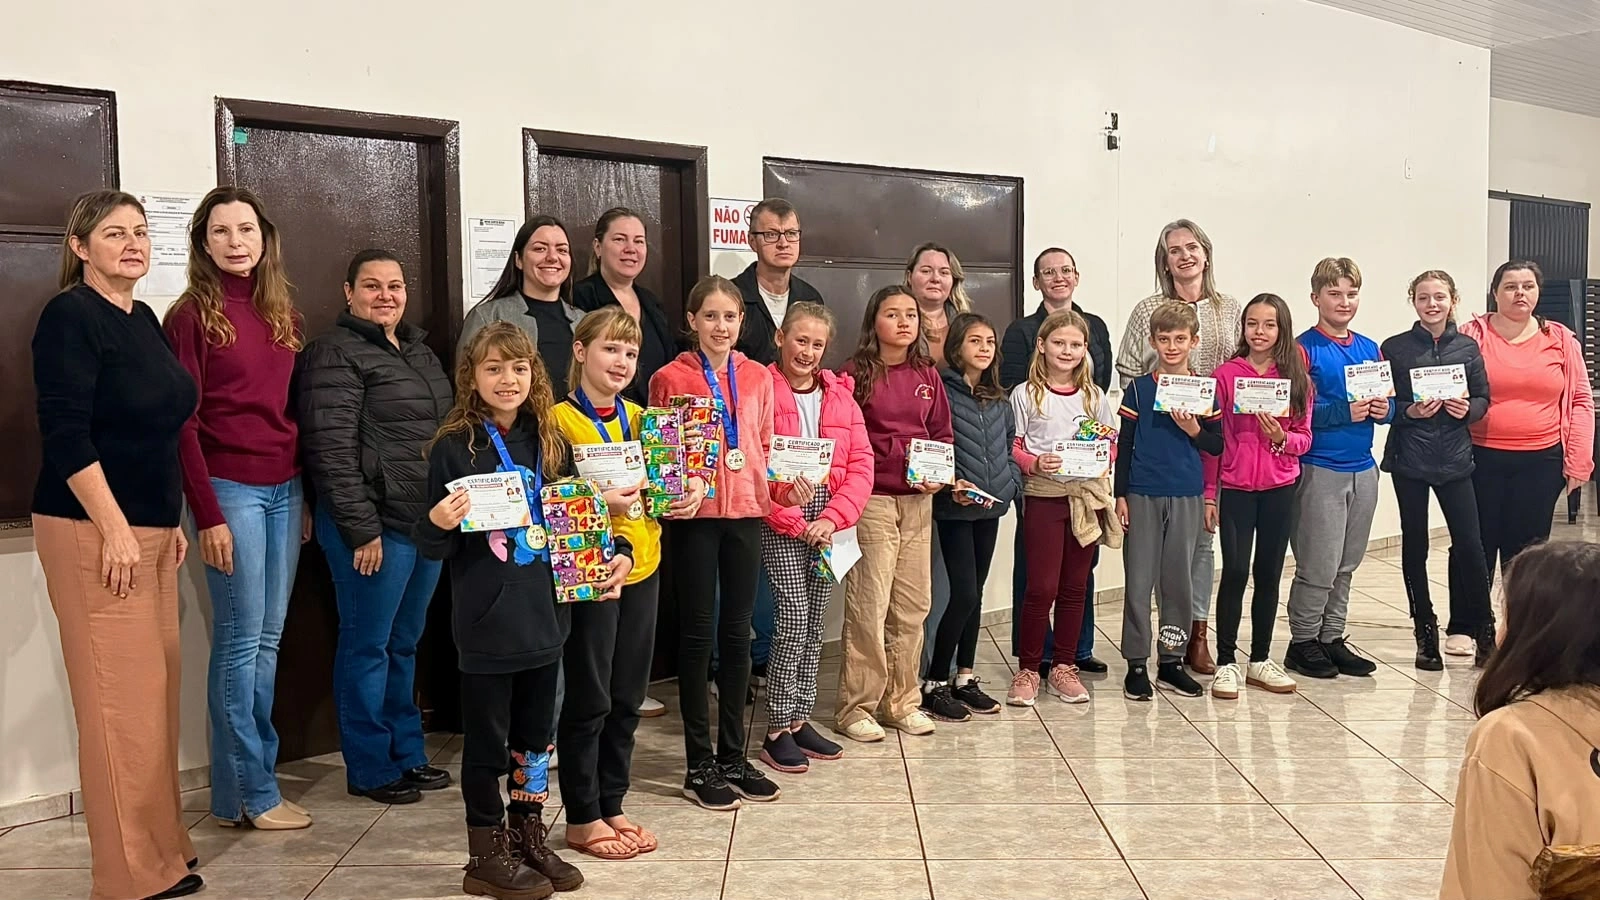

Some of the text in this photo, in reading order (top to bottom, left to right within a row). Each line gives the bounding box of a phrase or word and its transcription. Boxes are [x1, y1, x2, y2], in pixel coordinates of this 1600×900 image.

[714, 205, 740, 224] NÃO
[713, 228, 748, 245] FUMA
[659, 416, 668, 429] P
[662, 465, 672, 478] P
[551, 487, 559, 497] E
[568, 518, 589, 532] 3 4
[559, 538, 567, 550] E
[576, 567, 597, 583] 3 4
[568, 589, 575, 600] E
[1163, 630, 1182, 642] HIGH
[511, 789, 548, 802] STITCH
